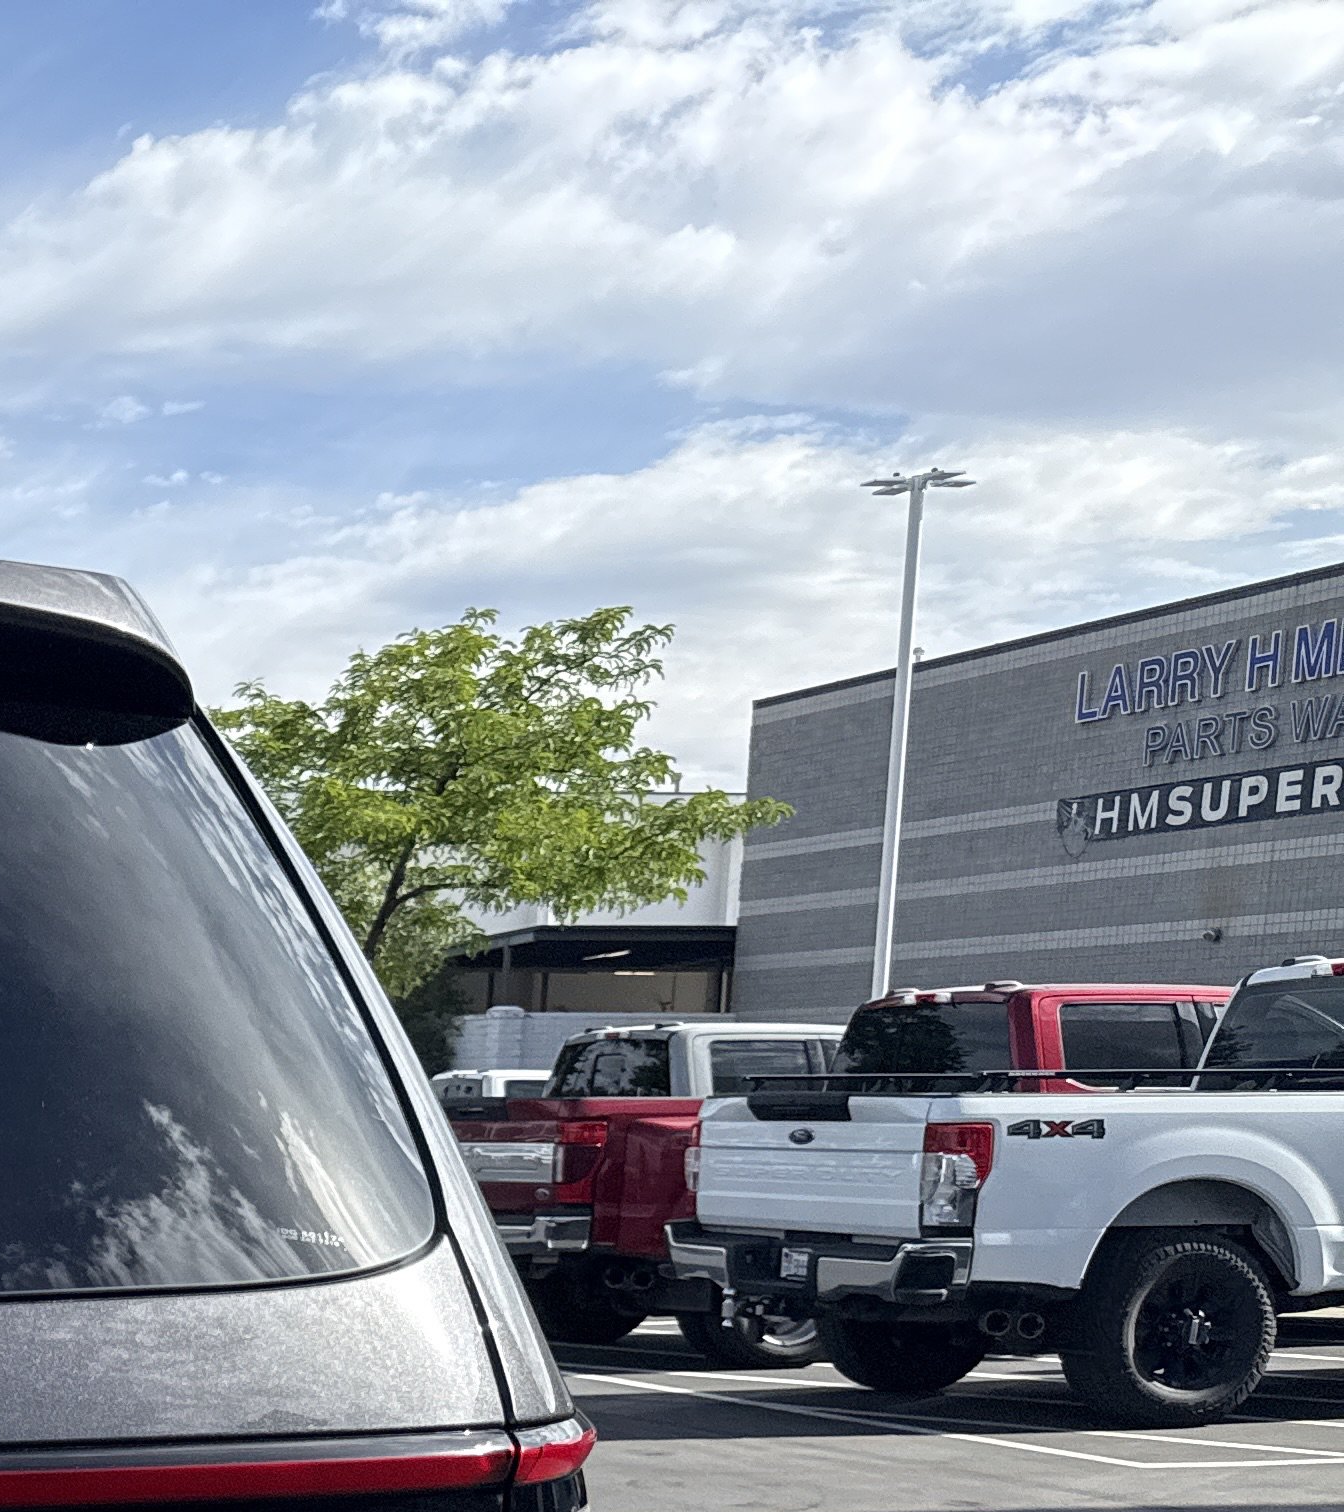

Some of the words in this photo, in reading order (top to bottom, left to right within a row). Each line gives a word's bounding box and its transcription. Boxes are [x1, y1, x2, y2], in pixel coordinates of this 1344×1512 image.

[1075, 640, 1237, 723] LARRY
[1245, 630, 1282, 692] H
[1143, 706, 1275, 767] PARTS
[1072, 764, 1343, 835] HMSUPER
